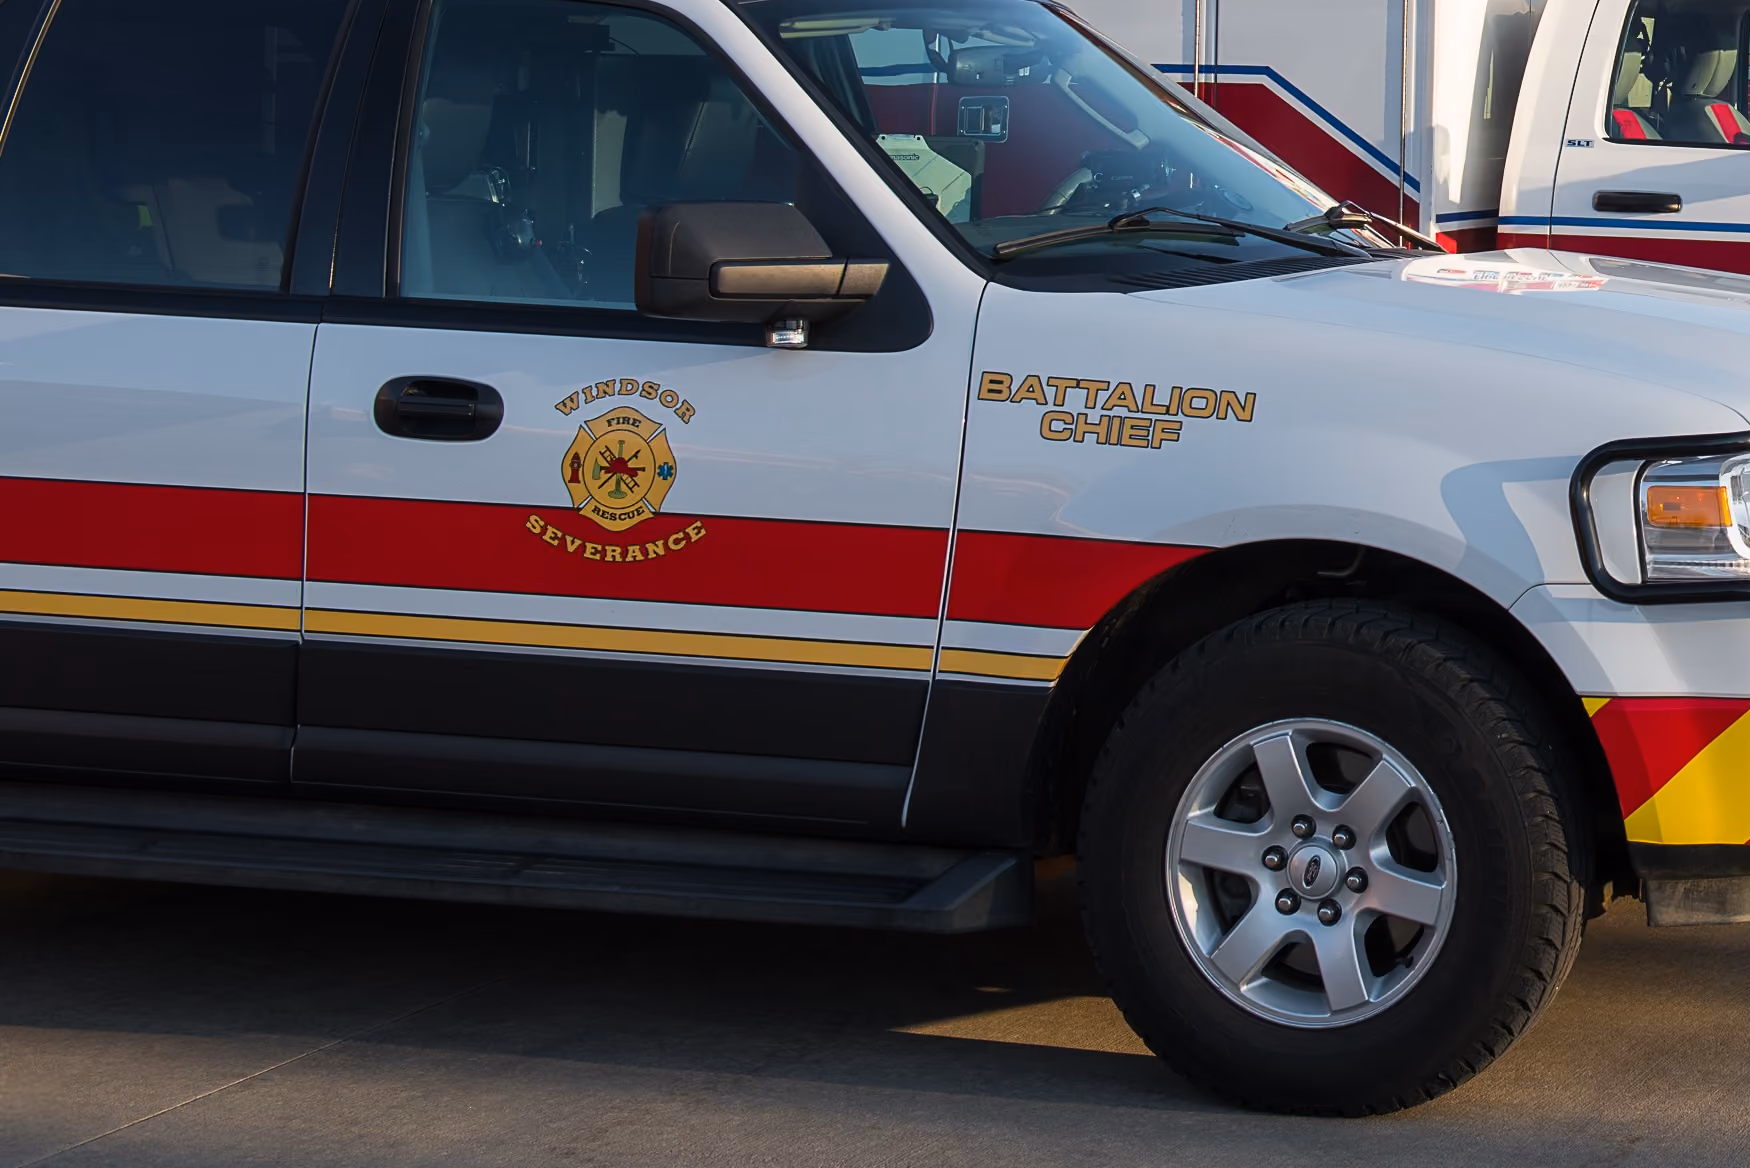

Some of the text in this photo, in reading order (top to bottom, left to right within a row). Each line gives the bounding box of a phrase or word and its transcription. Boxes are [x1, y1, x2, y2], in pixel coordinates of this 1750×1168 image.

[1567, 139, 1593, 147] SLT
[888, 153, 920, 161] nasonic
[554, 378, 696, 424] WINDSOR
[977, 371, 1256, 422] BATTALION
[606, 416, 641, 429] FIRE
[1040, 410, 1183, 449] CHIEF
[591, 505, 645, 521] RESCUE
[525, 514, 707, 562] SEVERANCE
